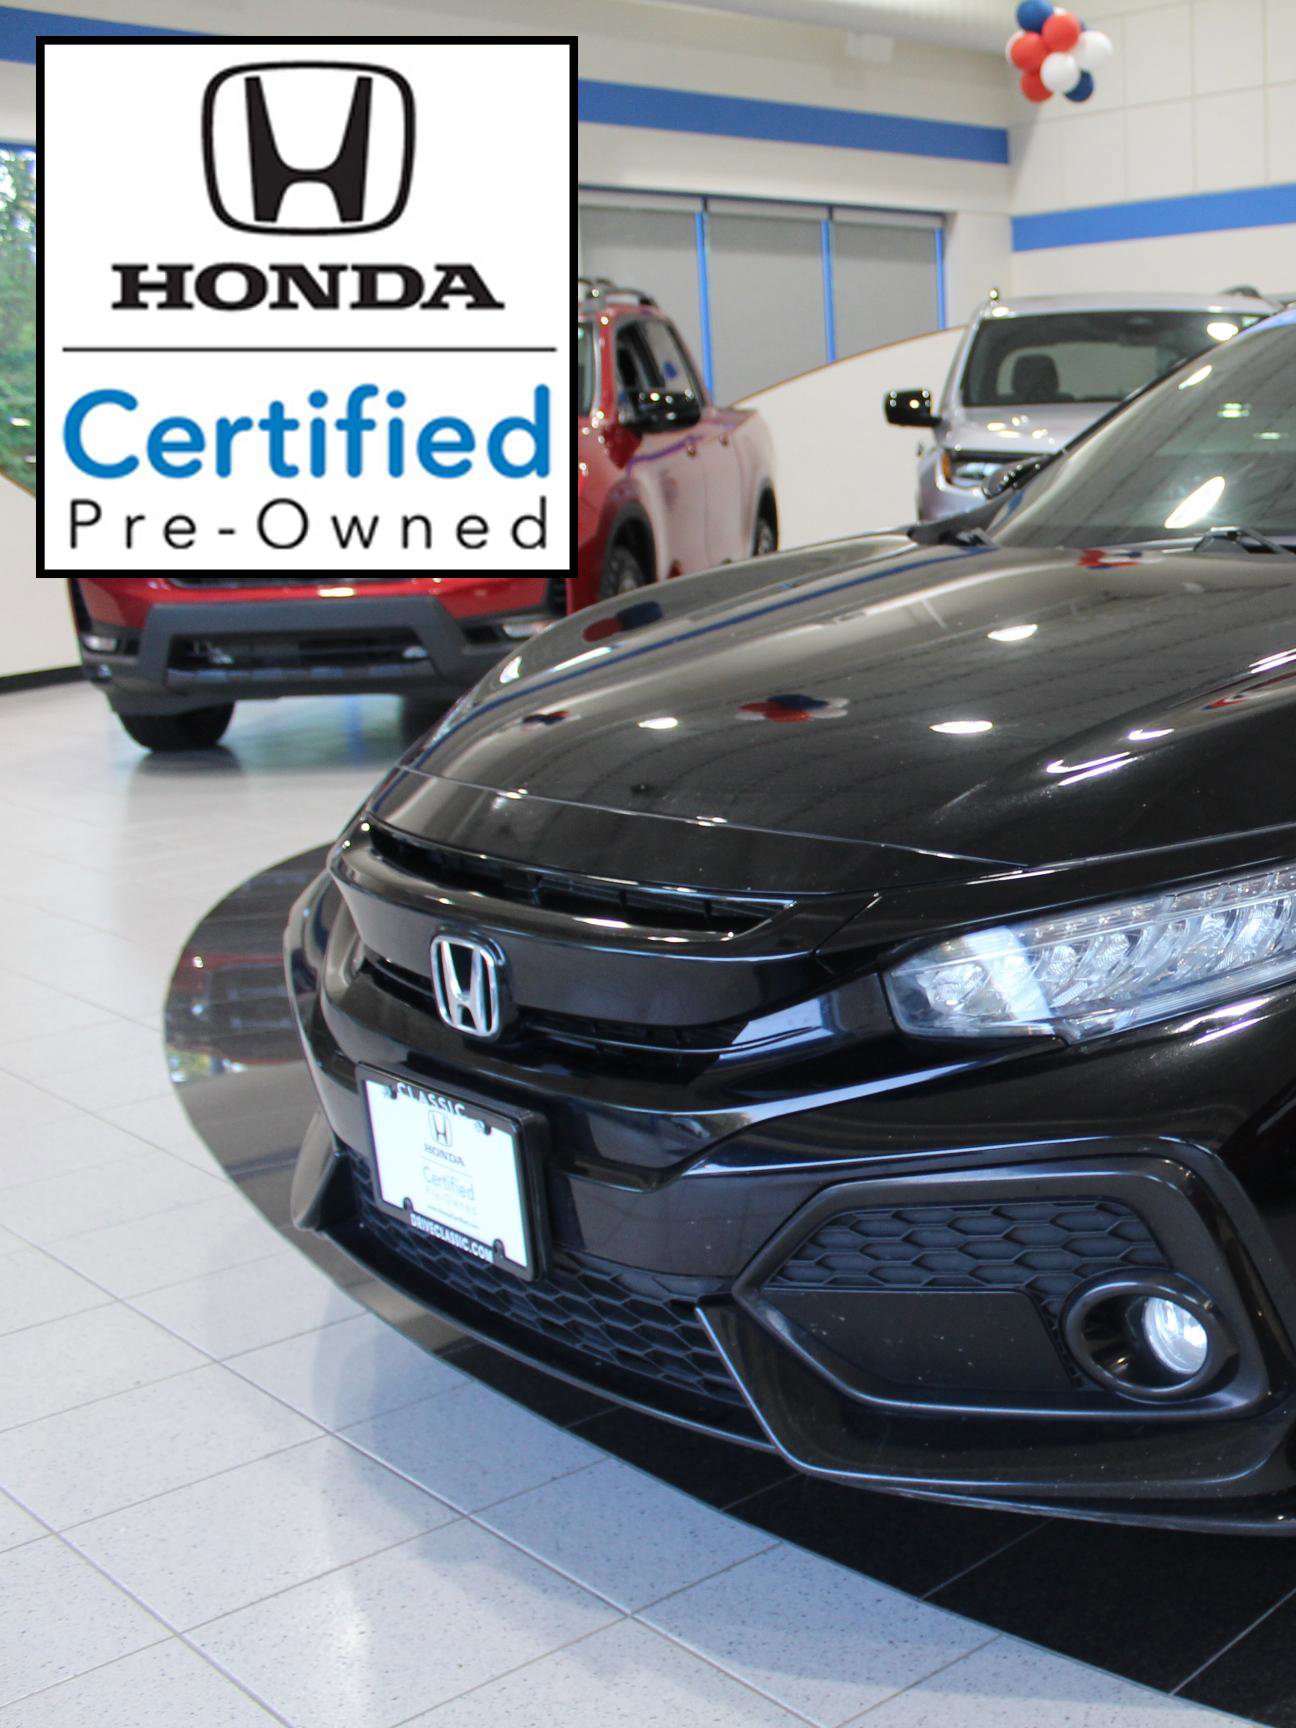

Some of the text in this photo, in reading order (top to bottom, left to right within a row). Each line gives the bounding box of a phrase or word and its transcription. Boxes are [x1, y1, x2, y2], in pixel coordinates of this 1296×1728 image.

[397, 1083, 465, 1118] CLASSIC
[424, 1143, 465, 1167] HONDA
[422, 1166, 476, 1201] Certified
